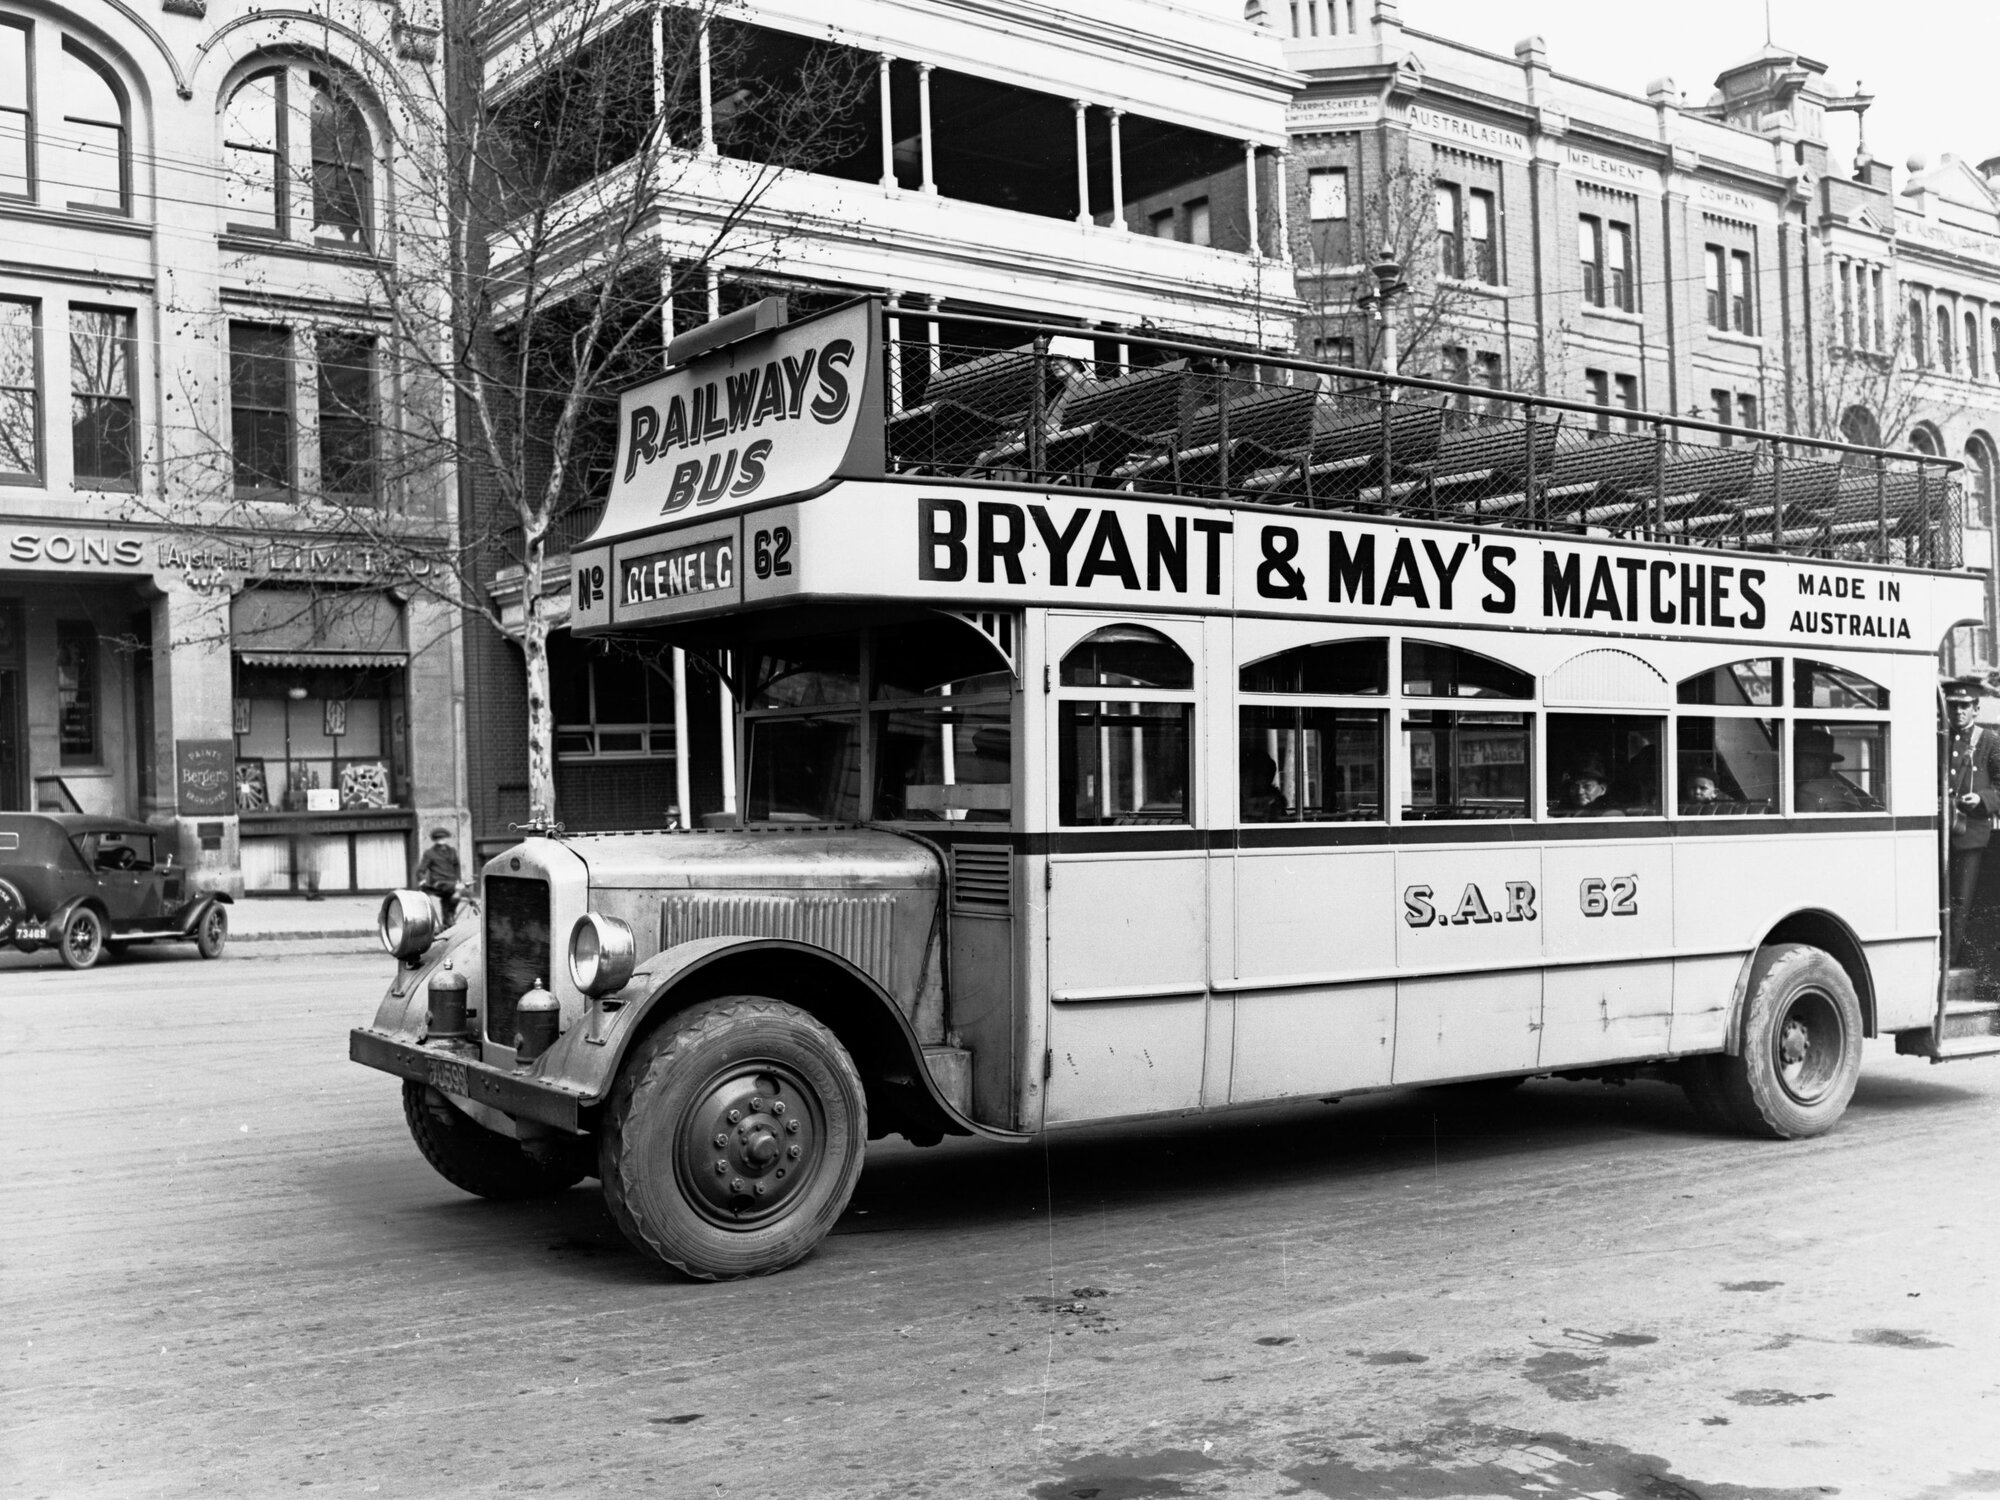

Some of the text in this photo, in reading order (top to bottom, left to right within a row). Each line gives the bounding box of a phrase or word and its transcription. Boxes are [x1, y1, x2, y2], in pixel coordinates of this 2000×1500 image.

[1409, 107, 1524, 152] AUSTRALASIAN
[1566, 147, 1645, 182] IMPLEMENT
[1700, 185, 1757, 209] COMPANY
[624, 339, 854, 484] RAILWAYS
[660, 439, 773, 516] BUS
[9, 534, 143, 567] SONS
[754, 526, 792, 579] 62
[918, 498, 1766, 630] BRYANT & MAY'S MATCHES
[1798, 573, 1900, 603] MADE IN
[1789, 610, 1911, 639] AUSTRALIA
[1579, 875, 1638, 917] 62
